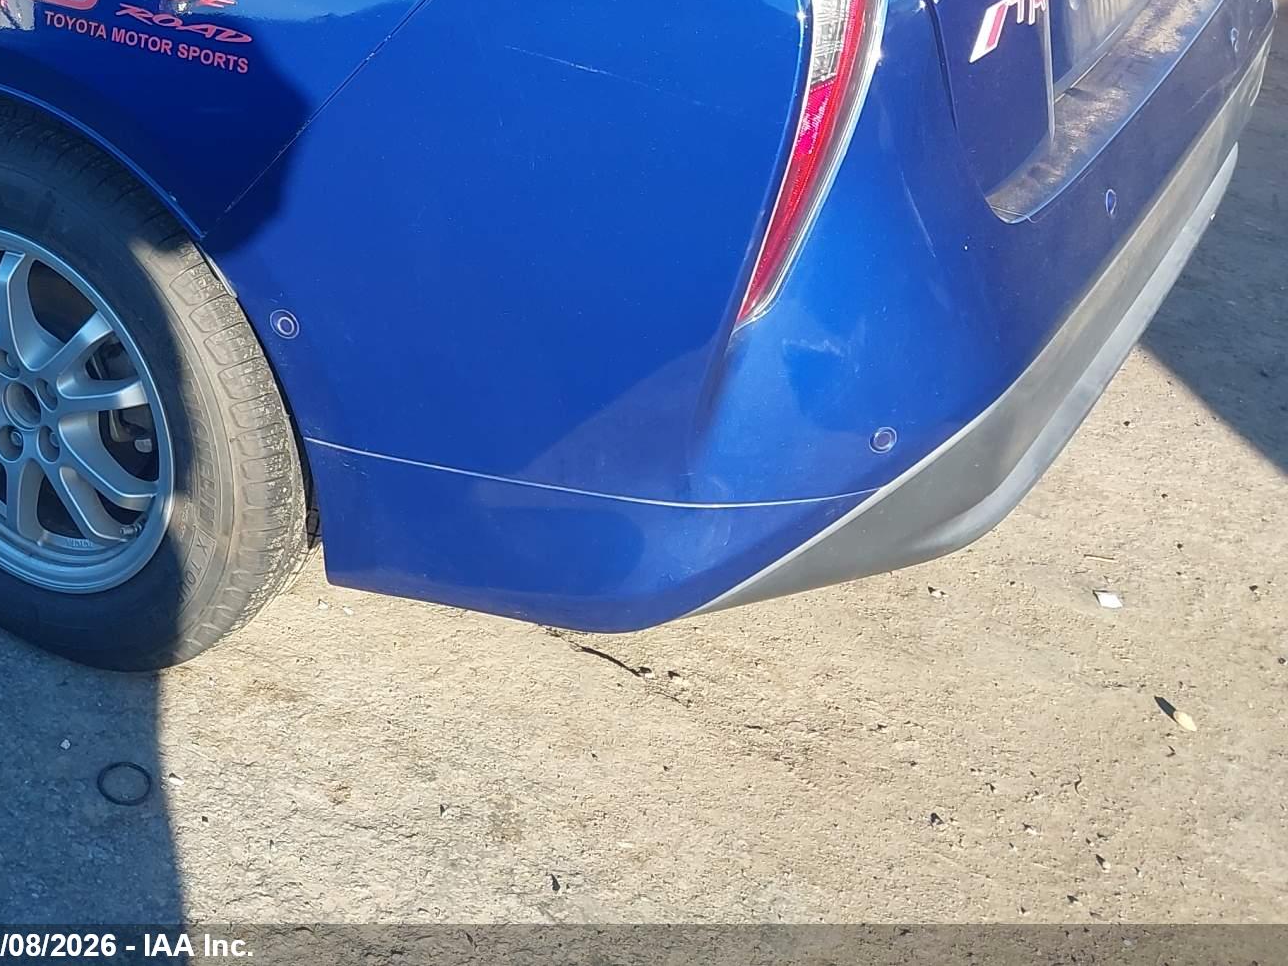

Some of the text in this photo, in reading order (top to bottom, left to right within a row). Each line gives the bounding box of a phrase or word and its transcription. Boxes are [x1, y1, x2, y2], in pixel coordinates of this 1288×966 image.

[44, 10, 249, 74] TOYOTA MOTOR SPORTS
[115, 2, 252, 43] ROAD
